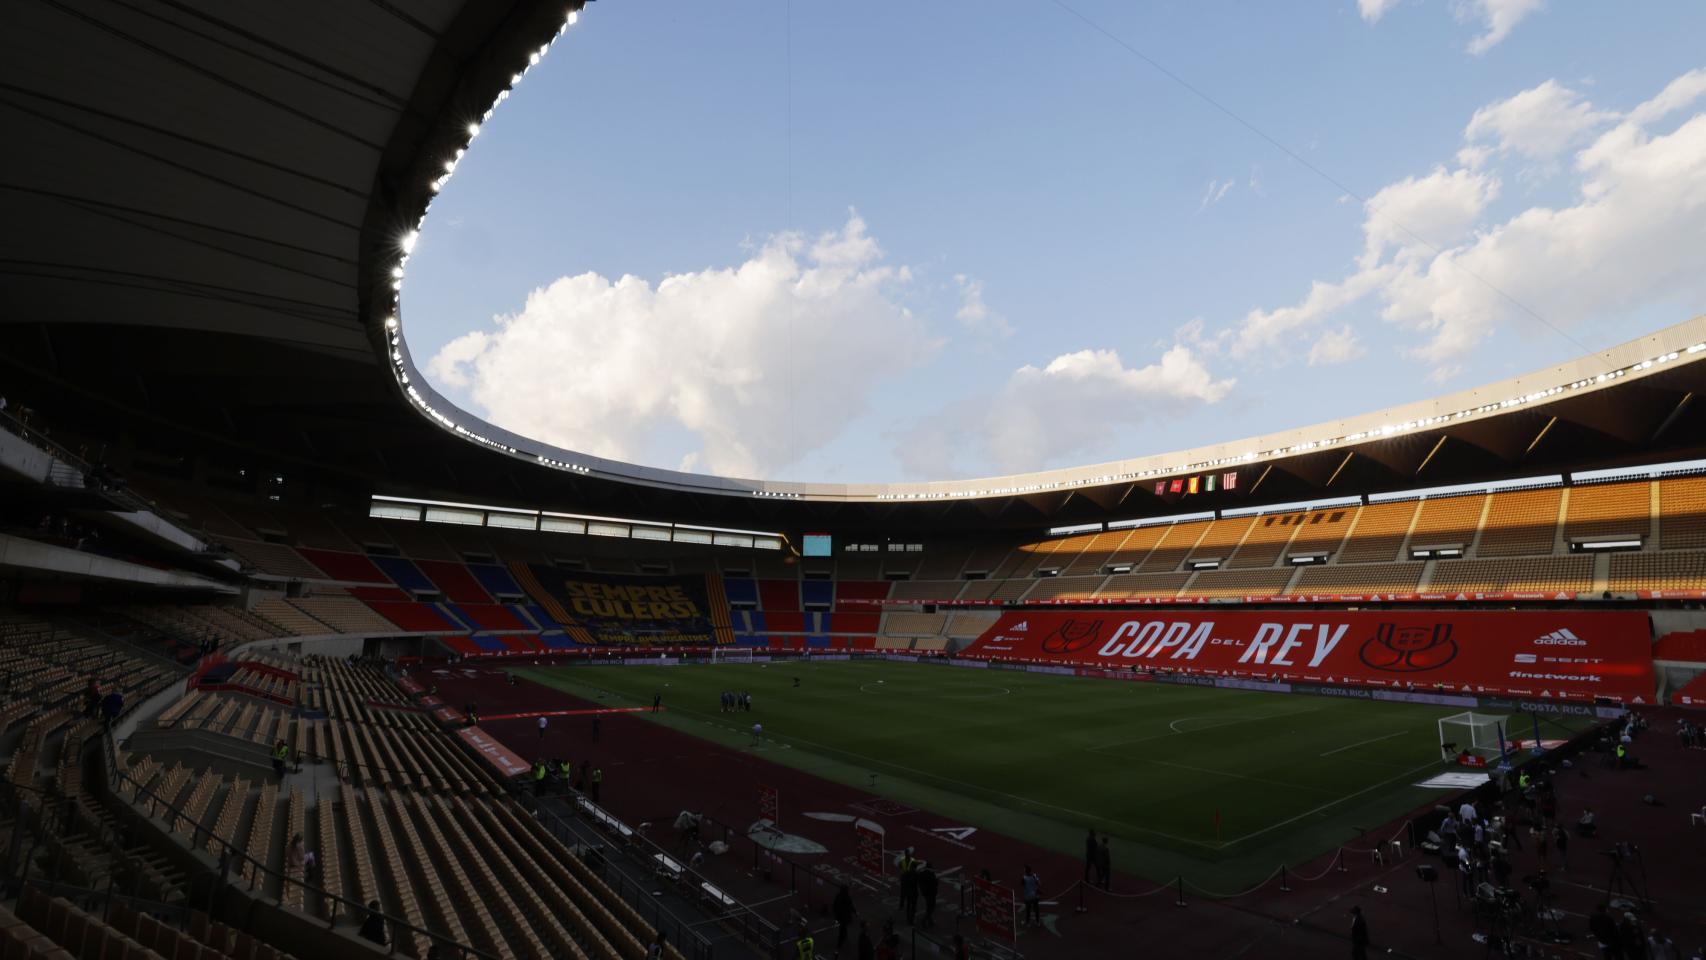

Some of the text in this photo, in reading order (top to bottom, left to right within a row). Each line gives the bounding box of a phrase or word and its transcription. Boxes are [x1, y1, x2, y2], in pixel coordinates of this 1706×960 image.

[564, 580, 689, 600] SEMPRE
[571, 597, 701, 619] CULERS!
[1098, 620, 1350, 667] COPA DEL REY
[1533, 638, 1588, 646] adidas
[1543, 656, 1603, 664] SEAT
[1508, 670, 1602, 682] finetwork
[1321, 687, 1348, 696] COSTA
[1349, 689, 1370, 698] RICA
[1521, 702, 1560, 713] COSTA
[1562, 705, 1592, 716] RICA
